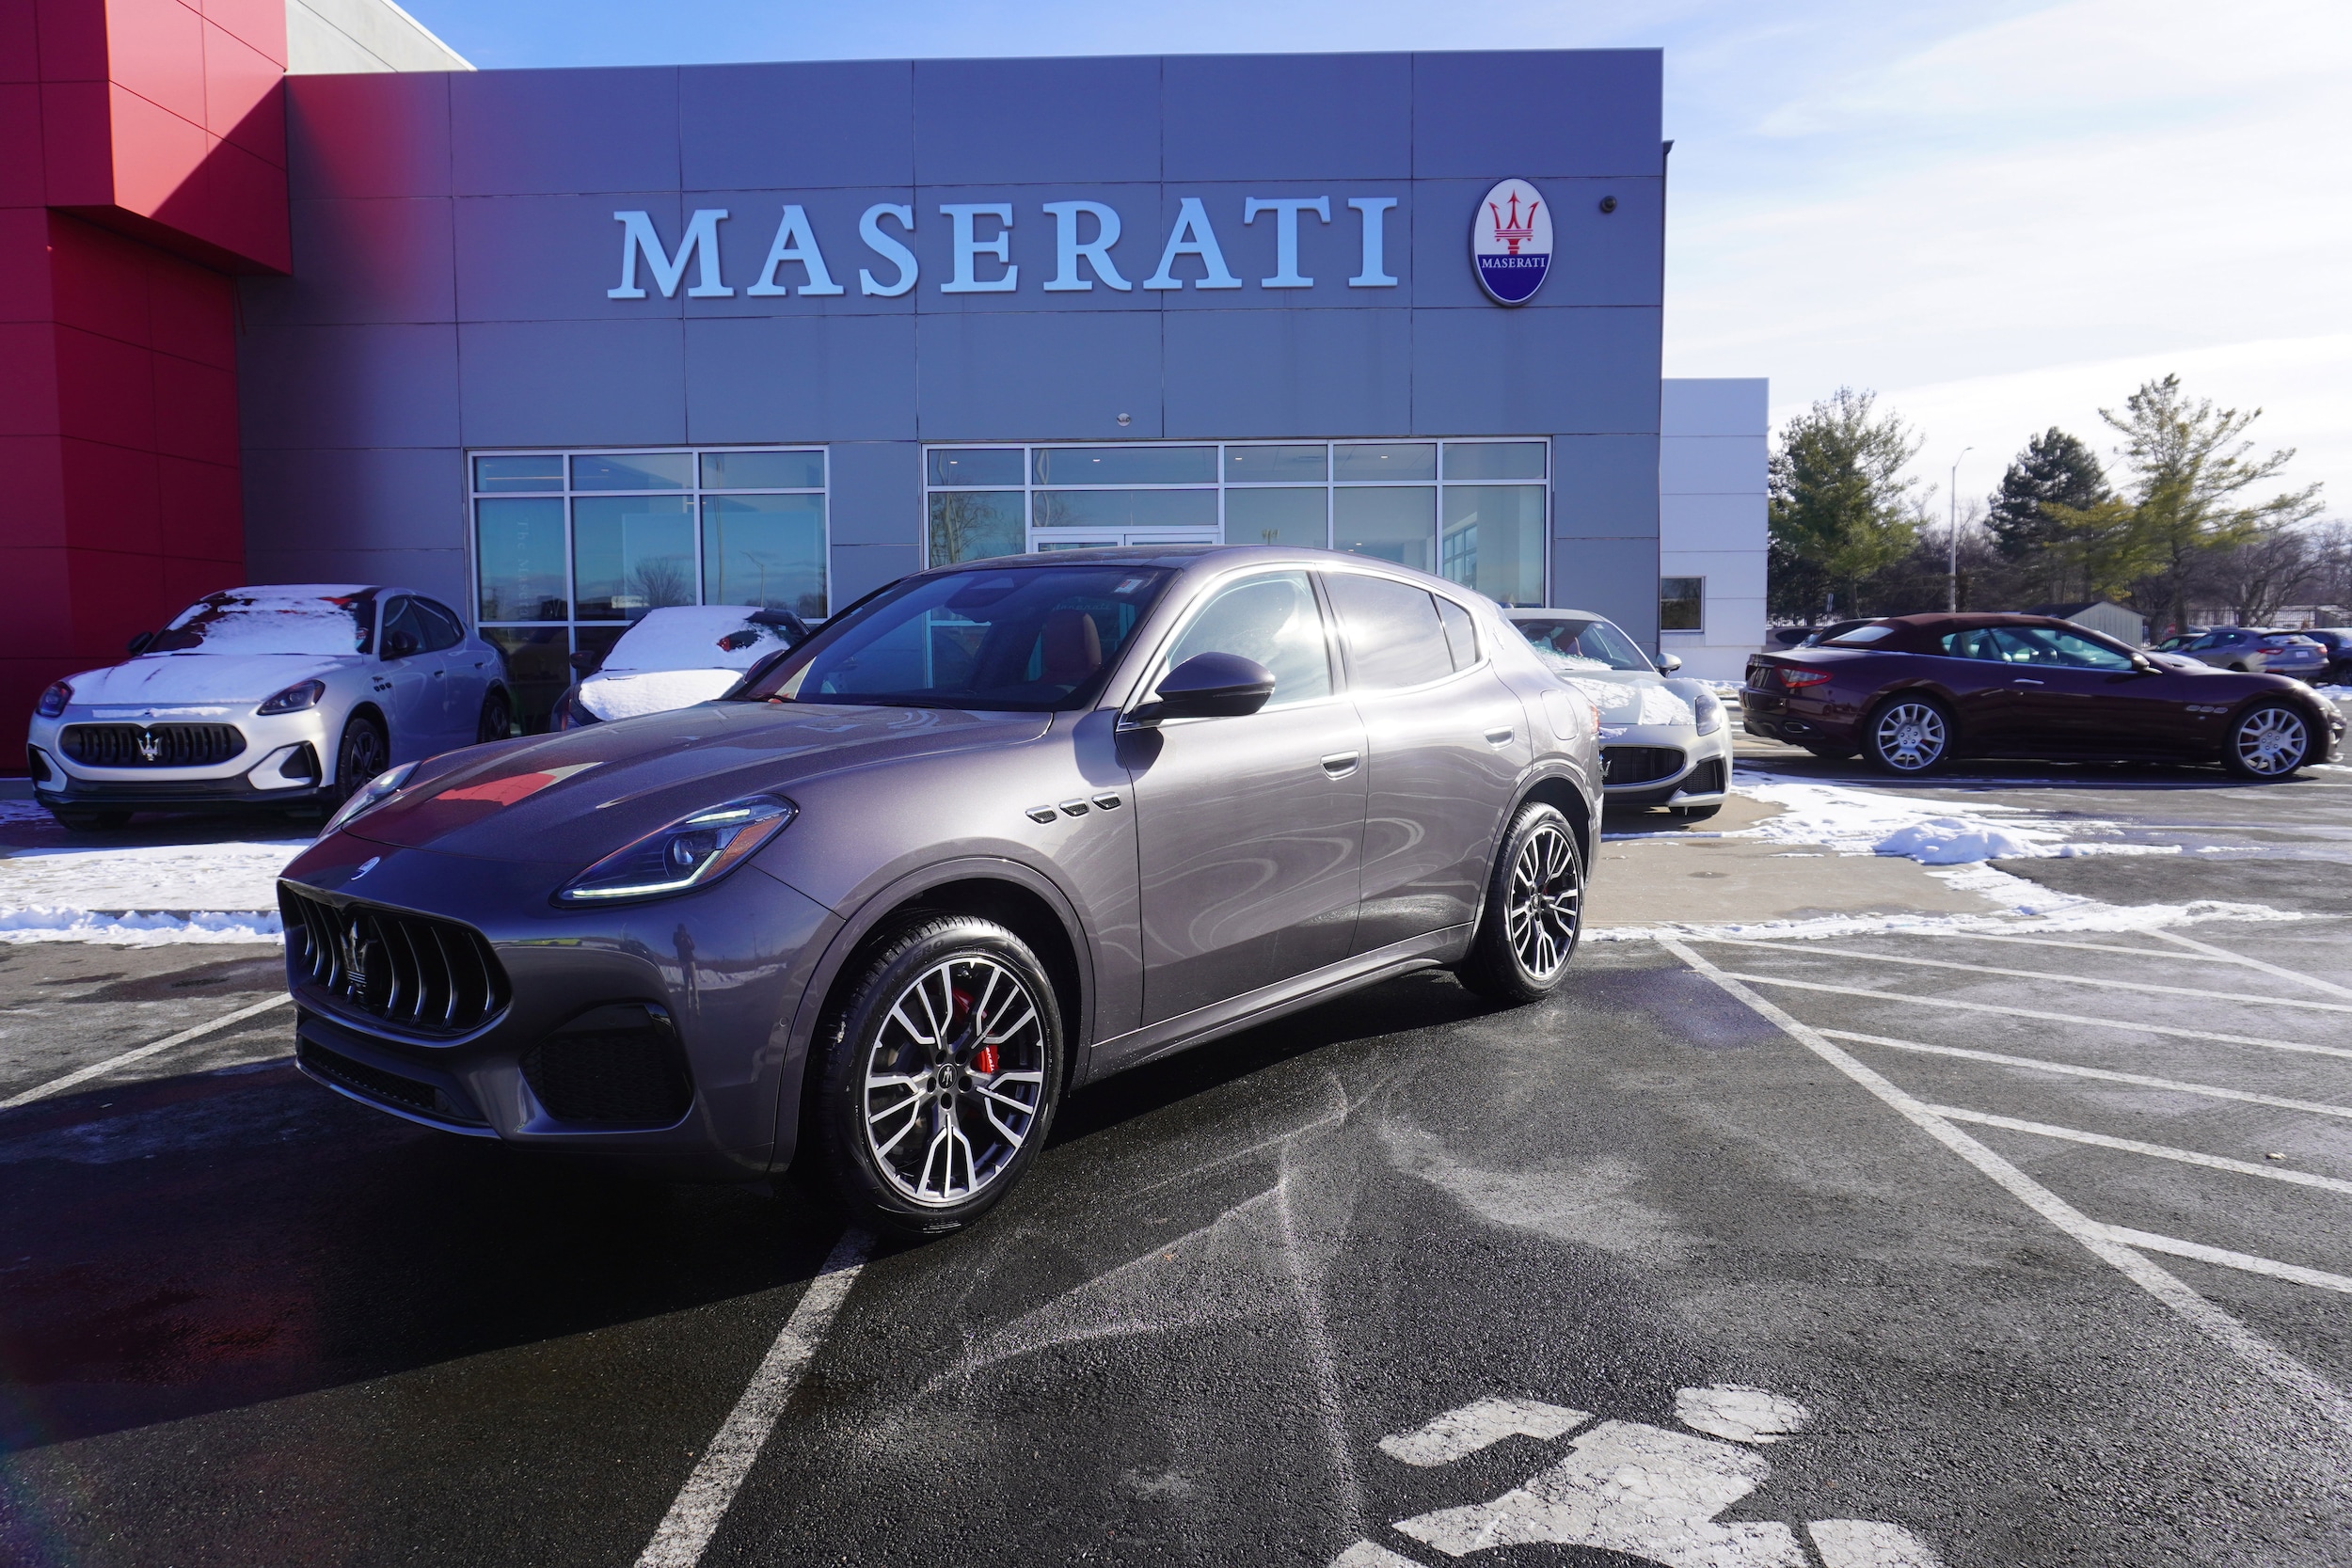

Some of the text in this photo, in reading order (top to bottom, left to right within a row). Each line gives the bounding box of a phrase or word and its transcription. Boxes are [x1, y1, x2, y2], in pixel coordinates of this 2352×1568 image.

[607, 196, 1398, 298] MASERATI
[1481, 257, 1546, 269] MASERATI
[516, 517, 530, 617] The Masera
